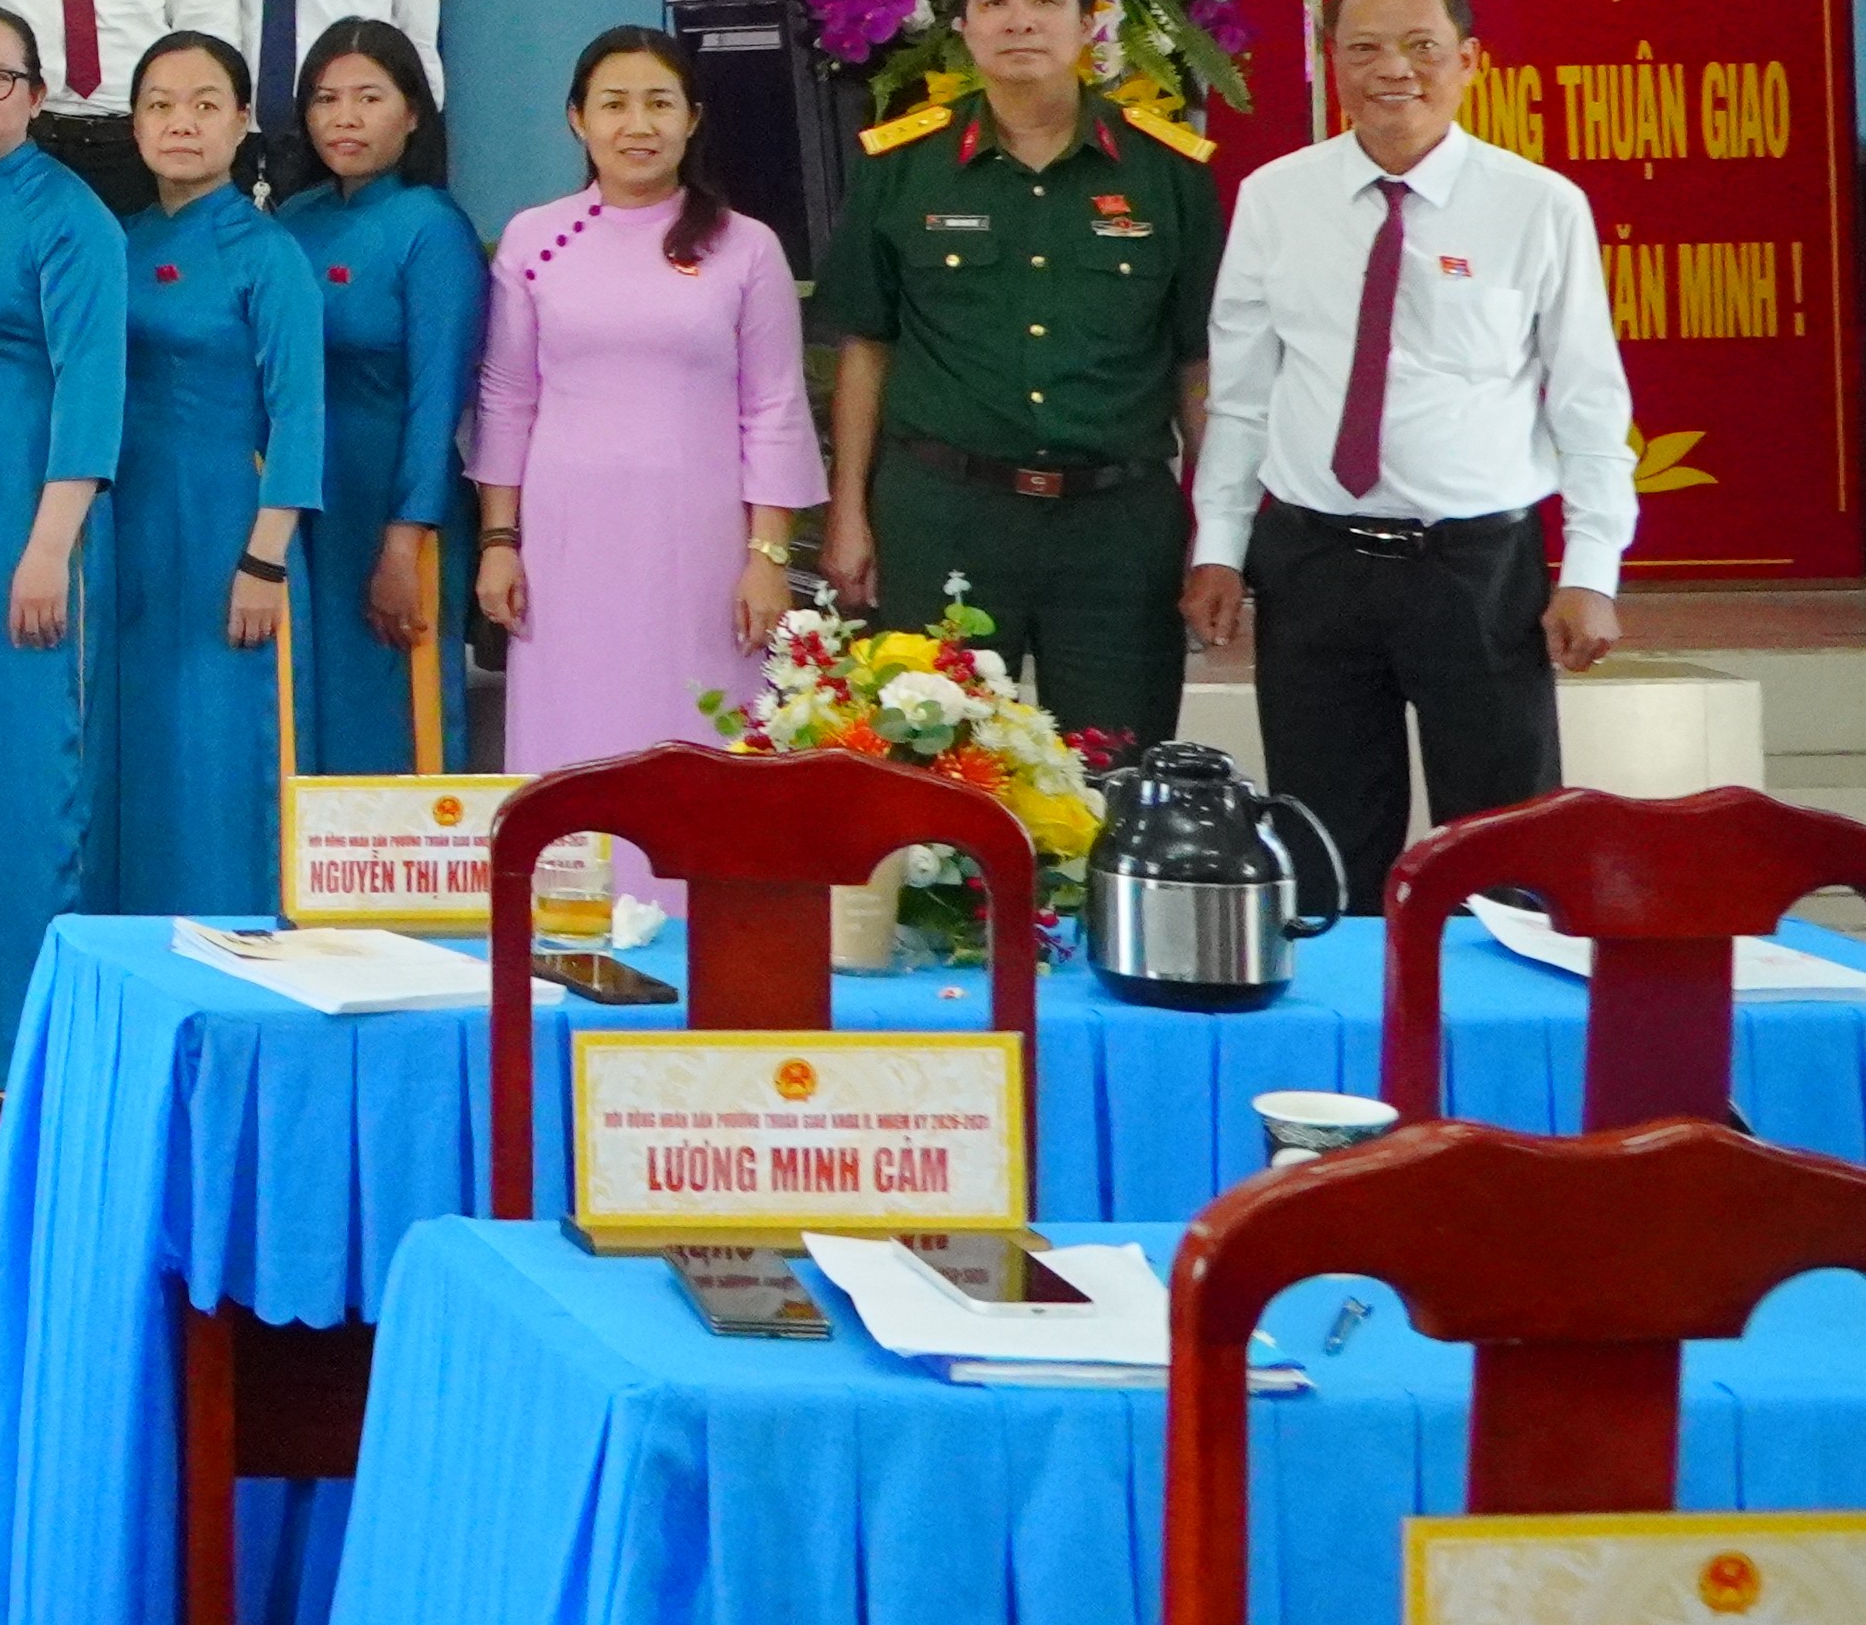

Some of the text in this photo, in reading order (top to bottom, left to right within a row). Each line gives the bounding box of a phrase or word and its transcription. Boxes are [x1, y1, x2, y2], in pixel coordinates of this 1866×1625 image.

[1557, 40, 1686, 176] THUẬN
[1702, 61, 1789, 159] GIAO
[1679, 243, 1776, 338] MINH
[310, 849, 395, 893] NGUYỄN
[403, 860, 438, 899] THỊ
[648, 1139, 757, 1192] LƯƠNG
[771, 1147, 860, 1192] MINH
